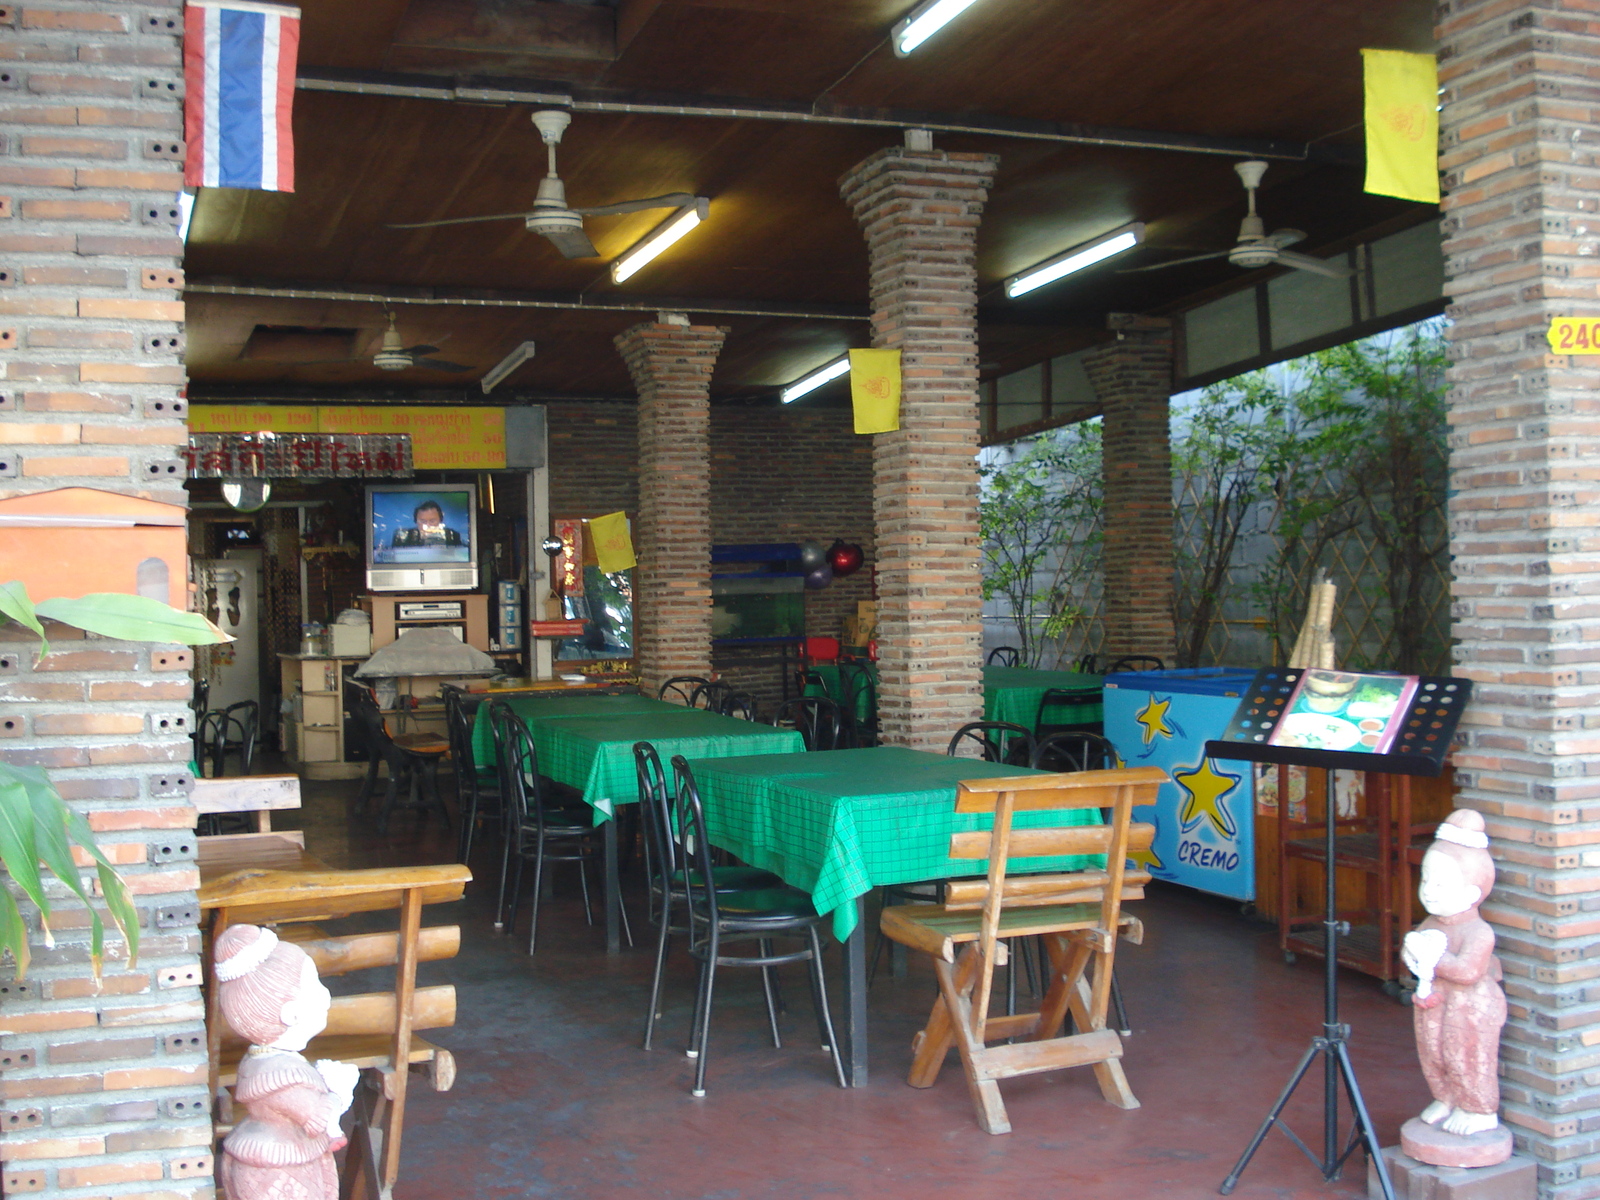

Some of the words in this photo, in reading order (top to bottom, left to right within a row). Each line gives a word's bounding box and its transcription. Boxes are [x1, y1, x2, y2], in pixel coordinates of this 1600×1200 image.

[287, 411, 312, 425] 120
[392, 414, 410, 426] 30
[292, 441, 404, 471] ปีใหม่
[1177, 840, 1240, 871] CREMO
